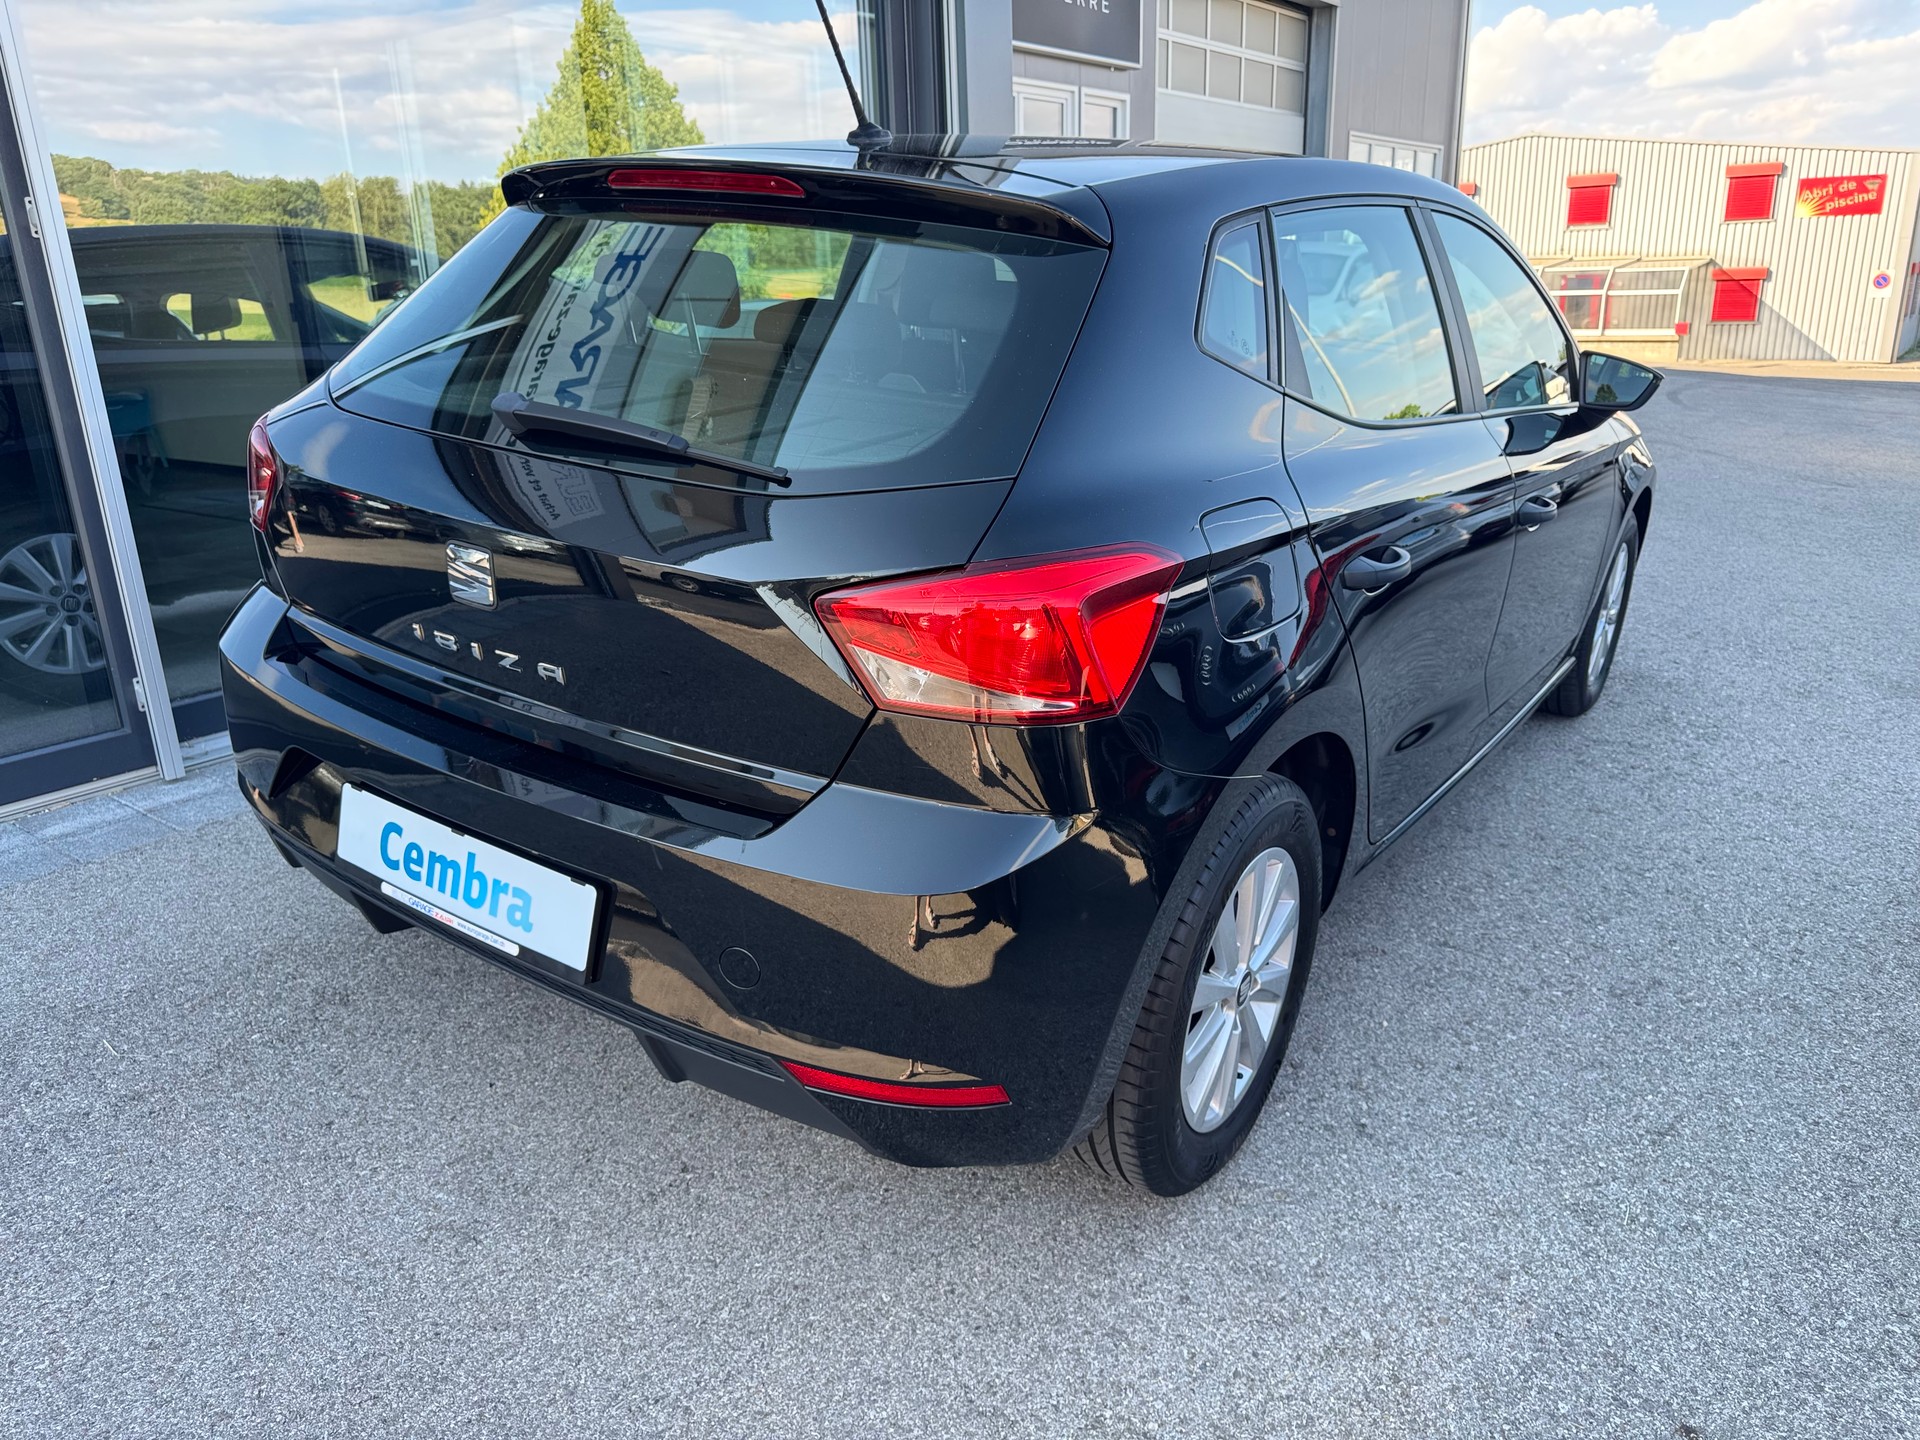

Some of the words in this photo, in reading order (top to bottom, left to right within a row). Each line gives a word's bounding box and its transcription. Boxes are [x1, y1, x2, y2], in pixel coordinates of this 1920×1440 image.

[1063, 0, 1110, 14] RE
[1803, 184, 1834, 202] Abri
[1838, 180, 1858, 193] de
[1825, 191, 1878, 213] piscine
[411, 622, 568, 686] IBIZA
[379, 821, 534, 934] Cembra
